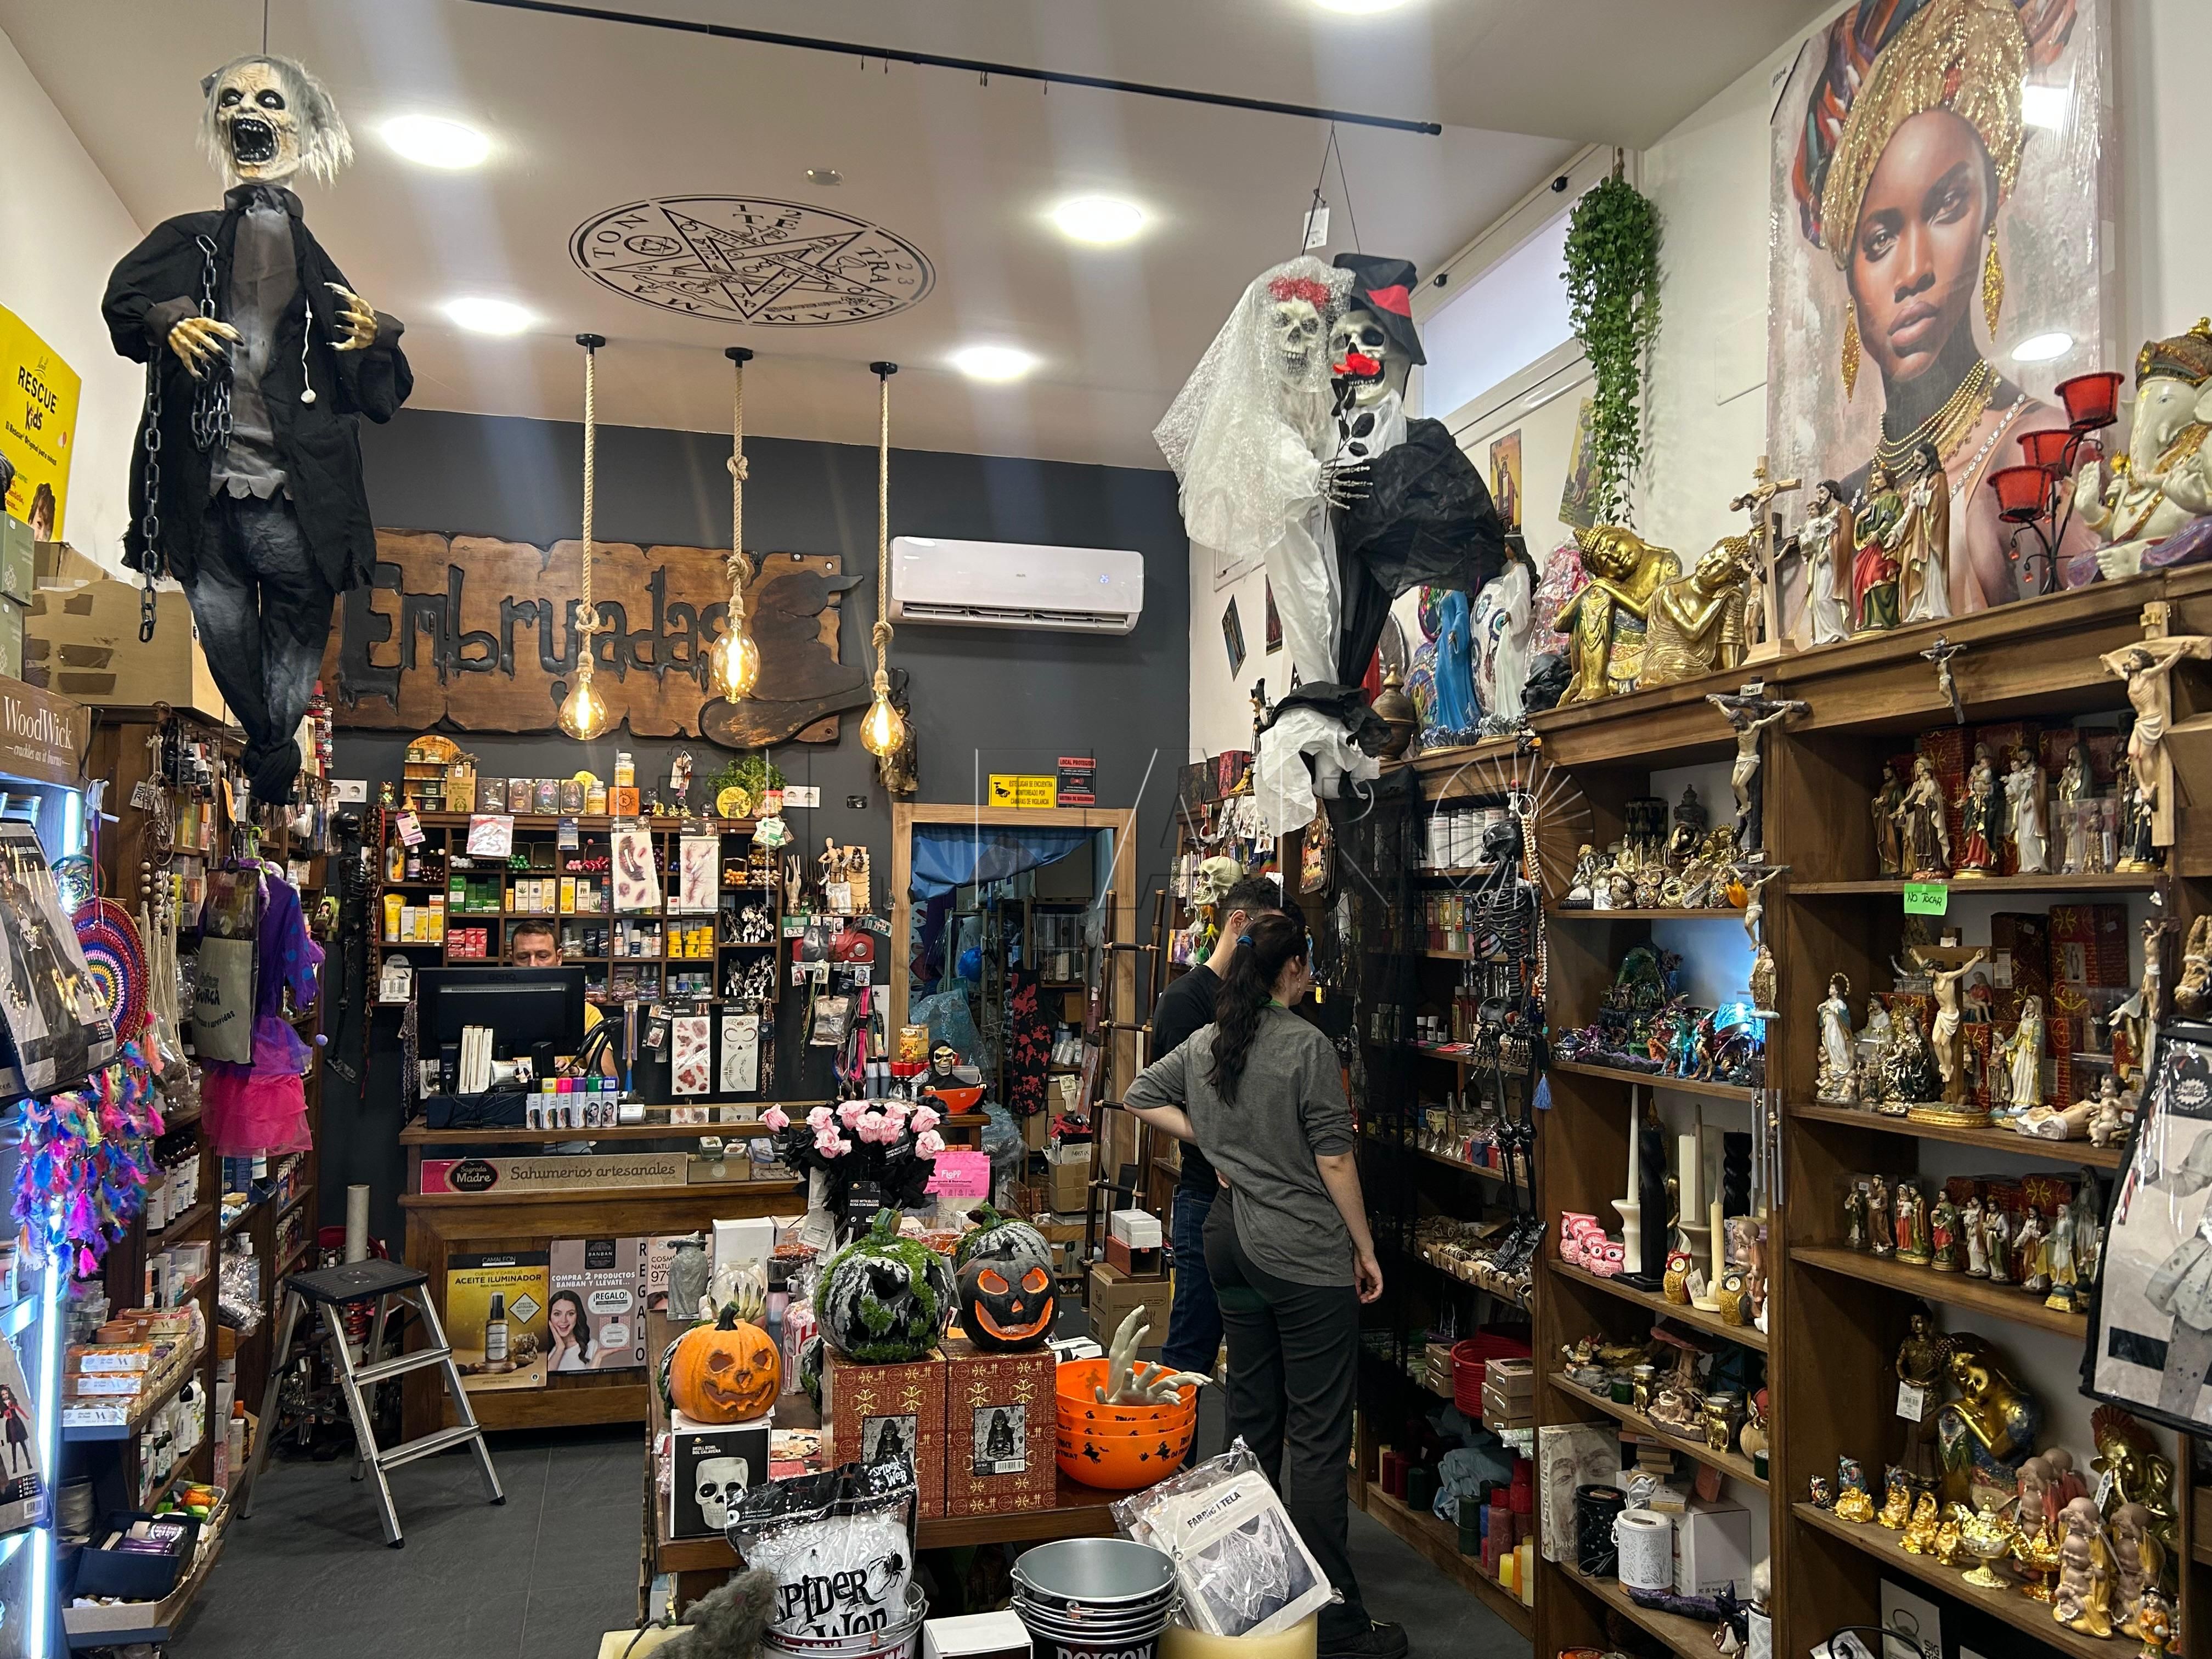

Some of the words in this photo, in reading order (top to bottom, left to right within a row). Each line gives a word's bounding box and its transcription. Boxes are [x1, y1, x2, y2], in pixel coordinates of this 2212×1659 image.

[18, 365, 57, 415] RESCUE
[14, 744, 35, 760] crackles
[35, 751, 42, 763] as
[47, 752, 63, 768] burns
[1907, 891, 1918, 903] NO
[1921, 892, 1943, 907] TOCAR
[460, 1165, 487, 1173] Sagrada
[510, 1164, 594, 1180] Sahumerios
[595, 1161, 676, 1177] artesanales
[456, 1172, 492, 1183] Madre
[455, 1276, 486, 1285] ACEITE
[487, 1274, 541, 1283] ILUMINADOR
[585, 1272, 591, 1280] 2
[594, 1272, 635, 1280] PRODUCTOS
[593, 1291, 627, 1302] ¡REGALO!
[635, 1242, 647, 1362] REGALO
[1219, 1491, 1242, 1508] TELA
